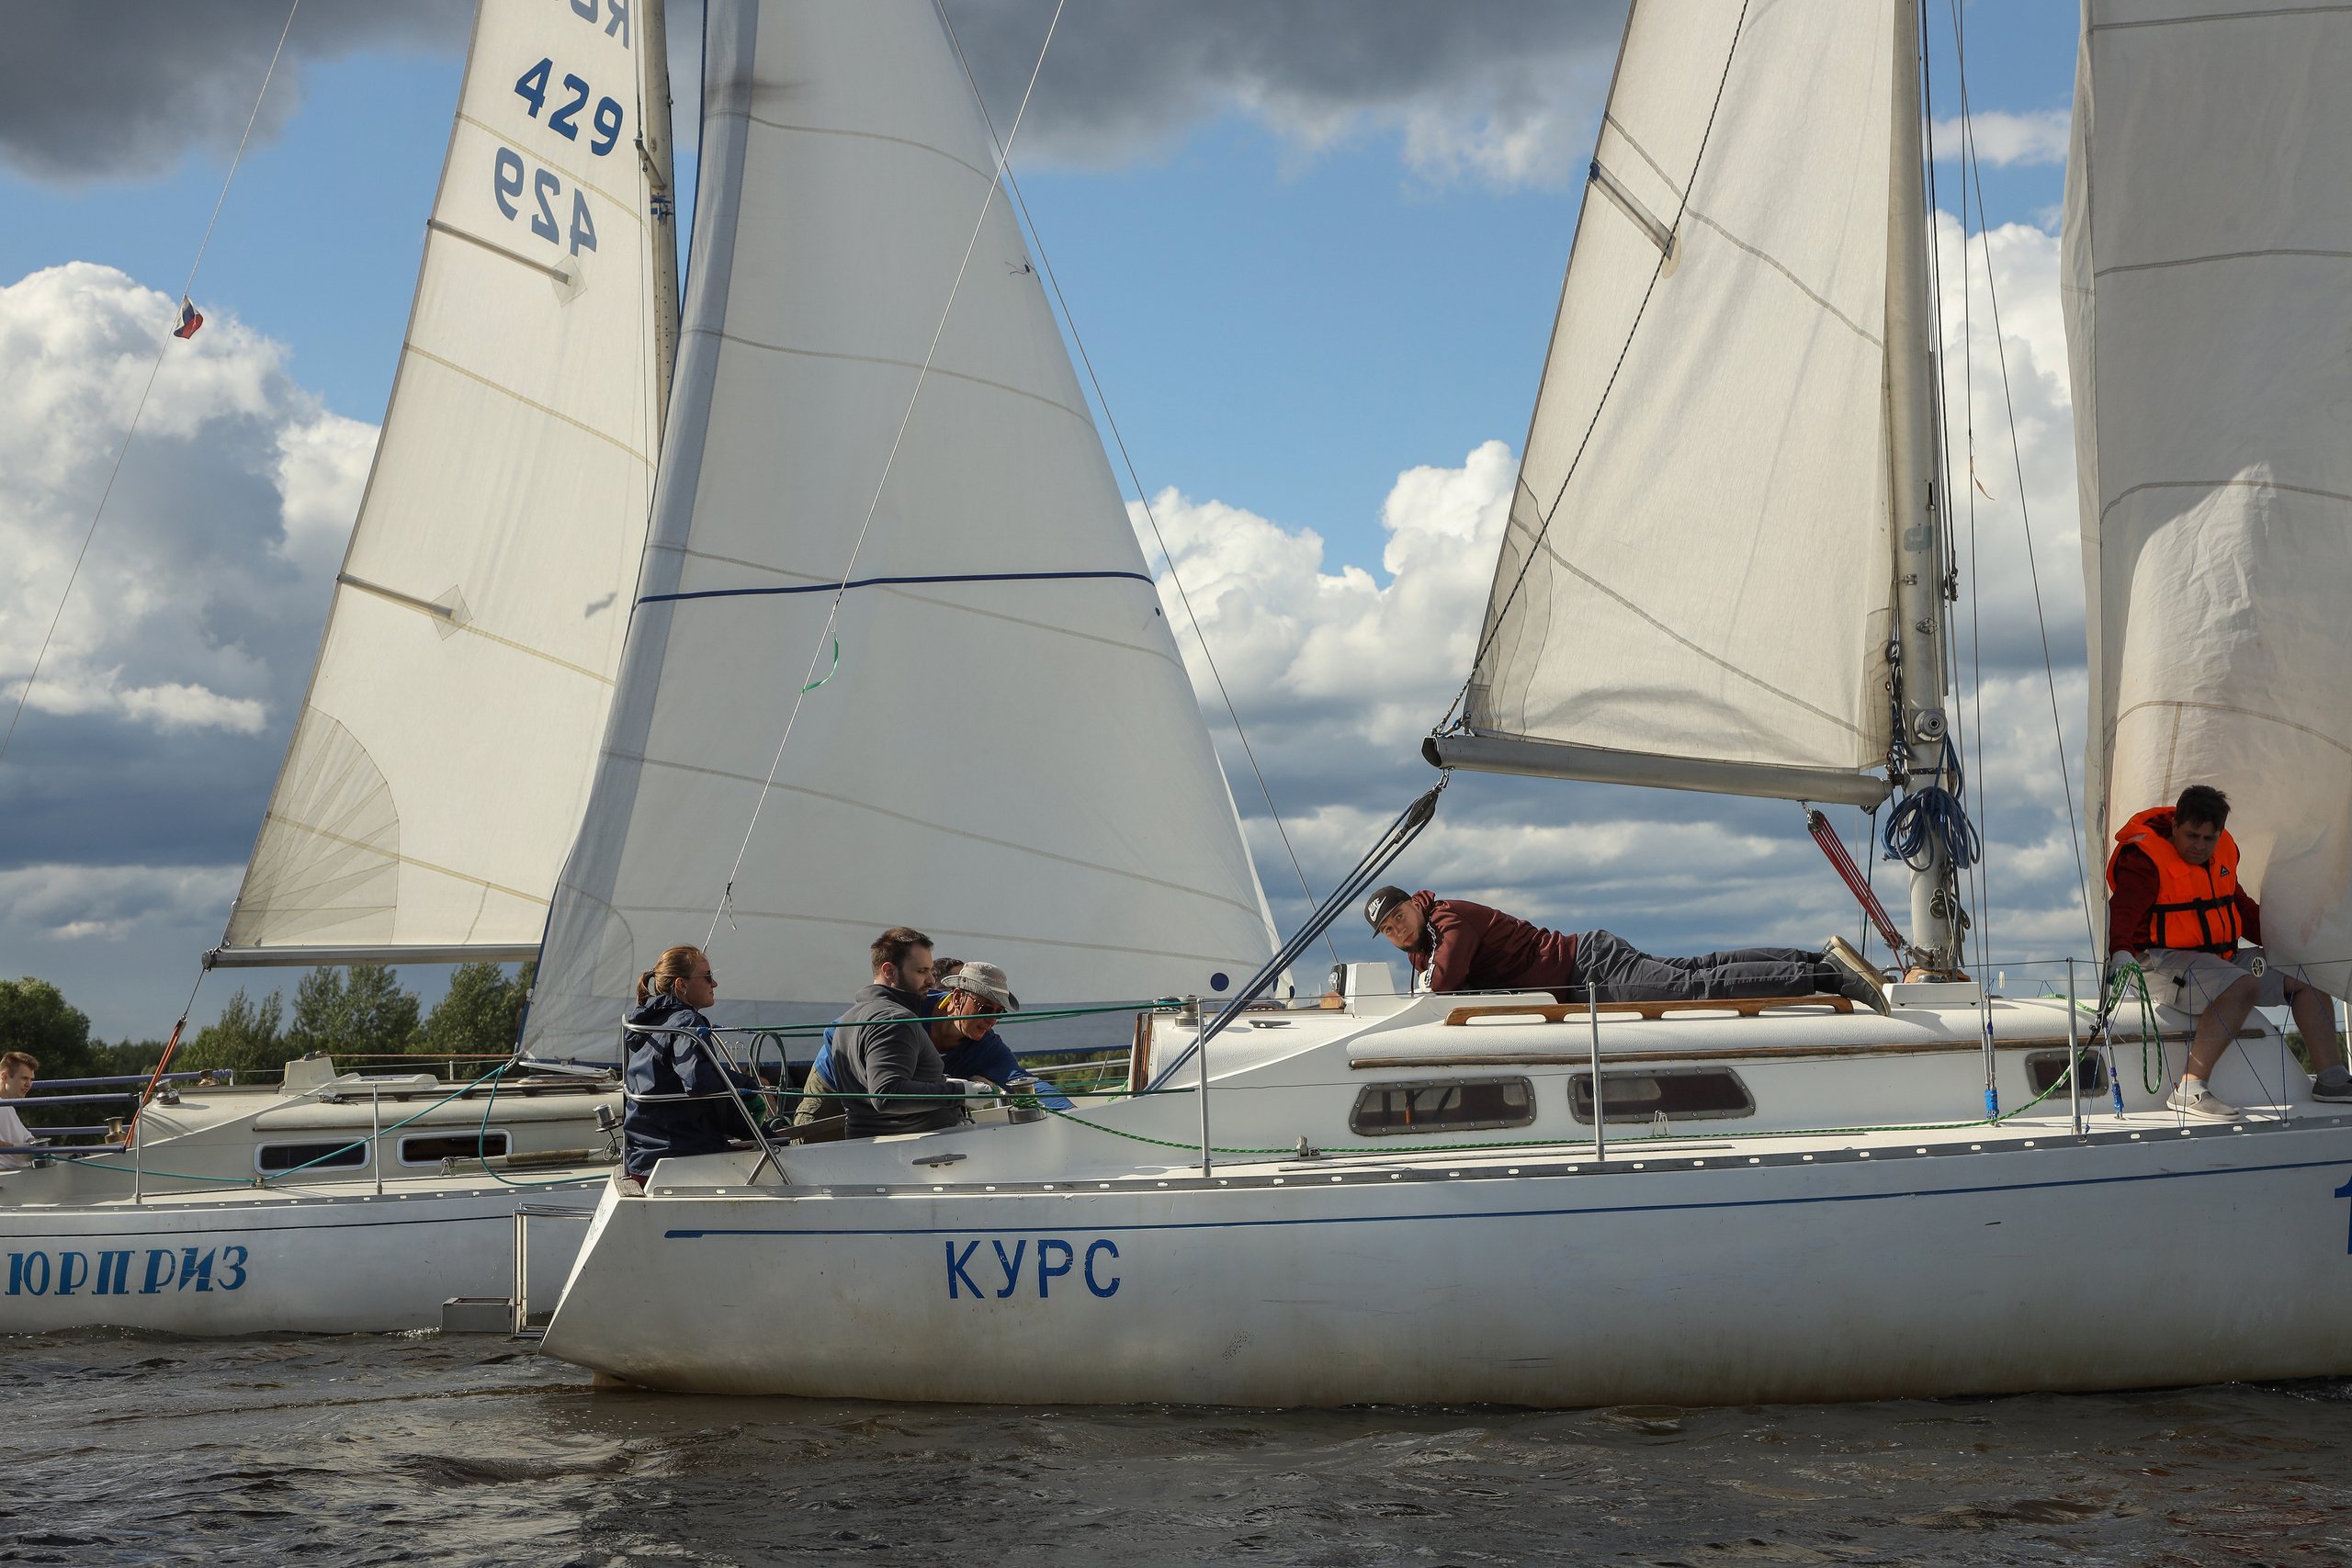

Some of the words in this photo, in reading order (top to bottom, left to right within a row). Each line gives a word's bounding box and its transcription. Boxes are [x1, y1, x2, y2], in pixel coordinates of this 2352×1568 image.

[514, 57, 623, 157] 429
[5, 1246, 248, 1296] ЮРПРИЗ
[945, 1238, 1121, 1299] КУРС
